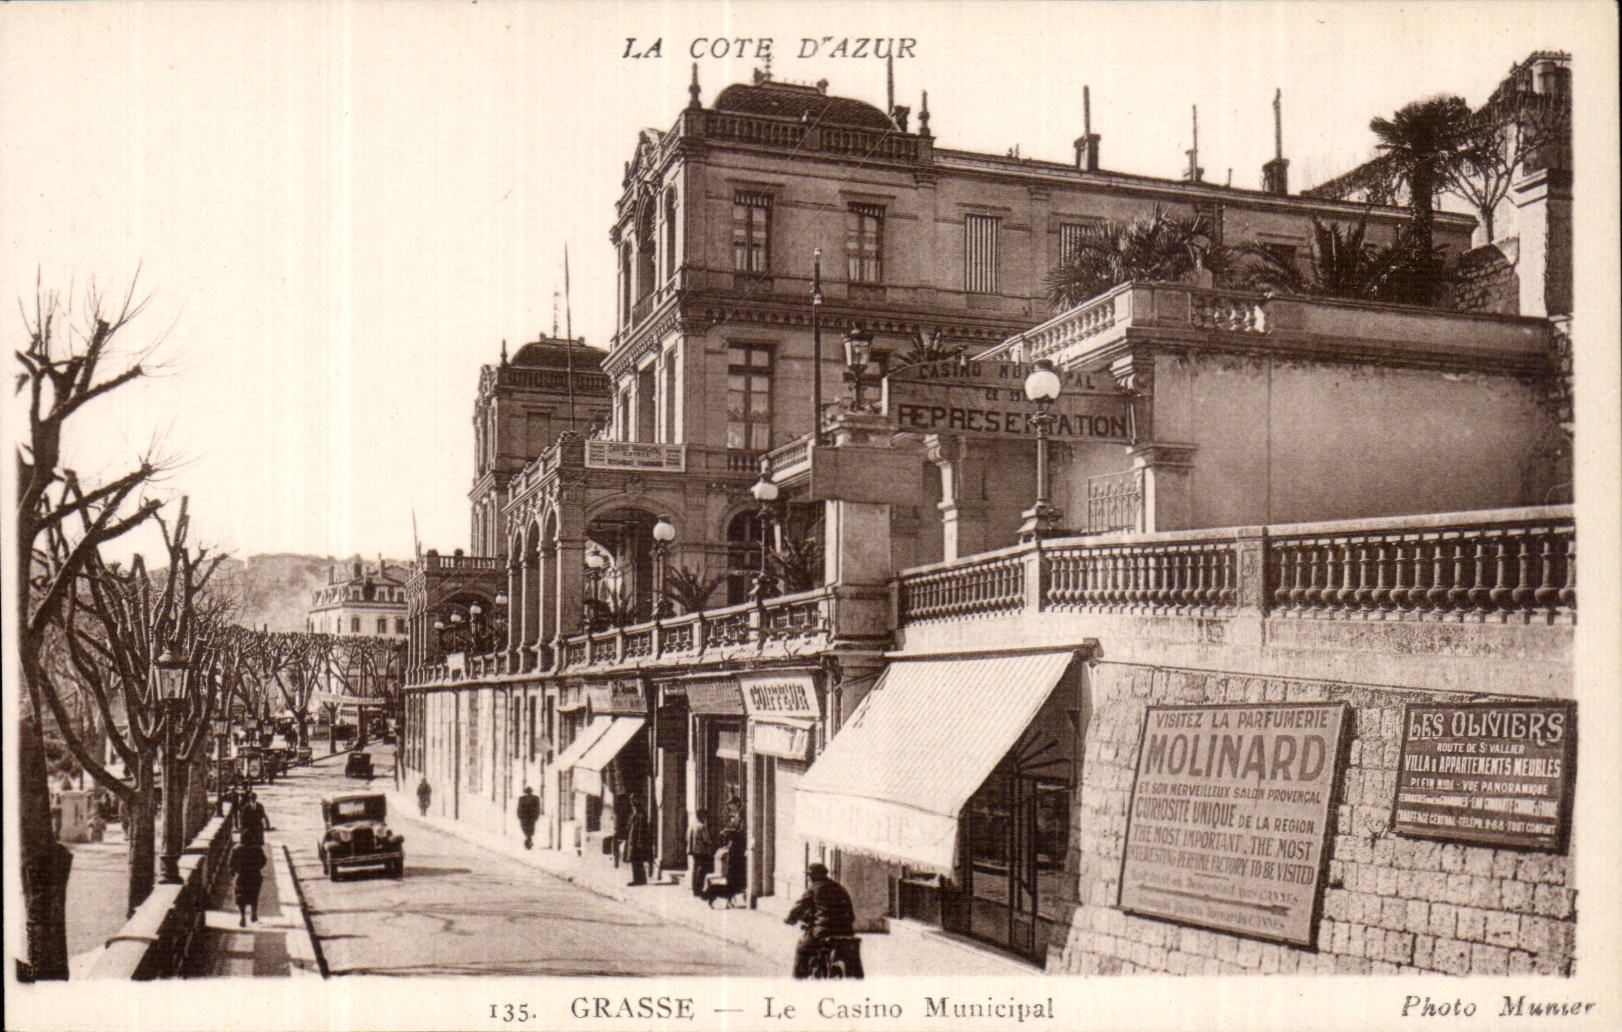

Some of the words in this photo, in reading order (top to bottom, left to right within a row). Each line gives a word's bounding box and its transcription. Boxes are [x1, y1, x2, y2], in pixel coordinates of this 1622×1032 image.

[919, 363, 981, 379] CASINO
[750, 683, 810, 711] COIFFEUR
[1156, 712, 1204, 729] VISITEZ
[1211, 711, 1229, 729] LA
[1238, 710, 1329, 729] PARFUMERIE
[1408, 712, 1444, 741] LES
[1451, 711, 1564, 746] OLIVIERS
[1145, 733, 1327, 782] MOLINARD
[1437, 742, 1465, 752] ROUTE
[1467, 743, 1477, 753] DE
[1489, 744, 1525, 755] VALLIER
[1405, 754, 1430, 772] VILLA
[1439, 756, 1511, 776] APPARTEMENTS
[1513, 758, 1560, 779] MEUBLES
[1139, 781, 1150, 793] ET
[1151, 782, 1168, 795] SON
[1169, 783, 1231, 798] MERVEILLEUX
[1233, 787, 1265, 800] SALON
[1267, 789, 1321, 805] PROVENÇAL
[1411, 777, 1434, 789] PLEIN
[1437, 778, 1454, 790] MIDI
[1463, 780, 1479, 792] VUE
[1481, 781, 1549, 796] PANORAMIQUE
[1136, 797, 1190, 822] CURIOSITE
[1192, 801, 1237, 829] UNIQUE
[1238, 815, 1252, 829] DE
[1256, 816, 1270, 831] LA
[1133, 824, 1152, 843] THE
[1153, 825, 1182, 846] MOST
[1250, 835, 1274, 857] THE
[1275, 838, 1313, 861] MOST
[1210, 854, 1249, 877] FACTORY
[1250, 859, 1262, 878] TO
[1262, 861, 1276, 880] BE
[1276, 863, 1316, 885] VISITED
